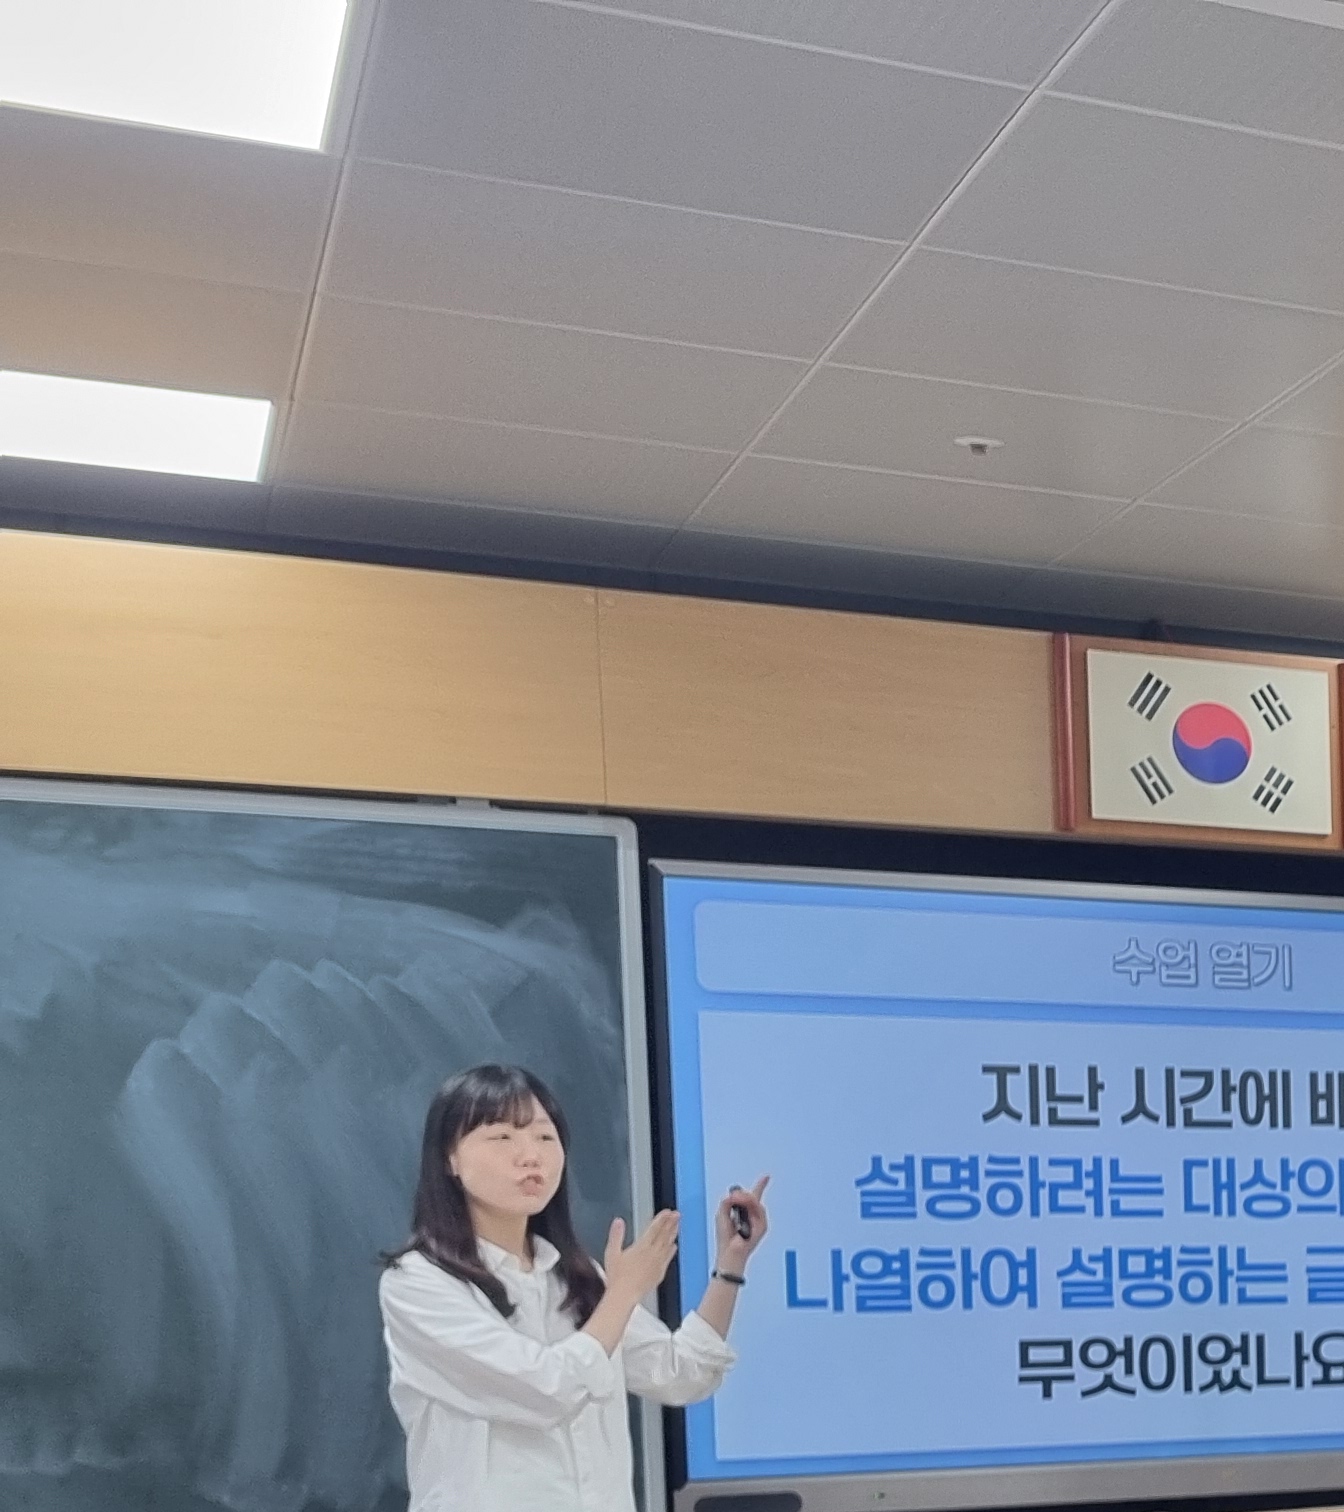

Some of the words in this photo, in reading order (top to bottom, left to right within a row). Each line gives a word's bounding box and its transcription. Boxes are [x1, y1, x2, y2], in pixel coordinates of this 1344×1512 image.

[1112, 935, 1200, 988] 수업
[1209, 940, 1294, 991] 열기
[981, 1062, 1105, 1128] 지난
[1120, 1065, 1292, 1130] 시간에
[854, 1153, 1165, 1221] 설명하려는
[785, 1246, 1039, 1314] 나열하여
[1057, 1244, 1289, 1310] 설명하는
